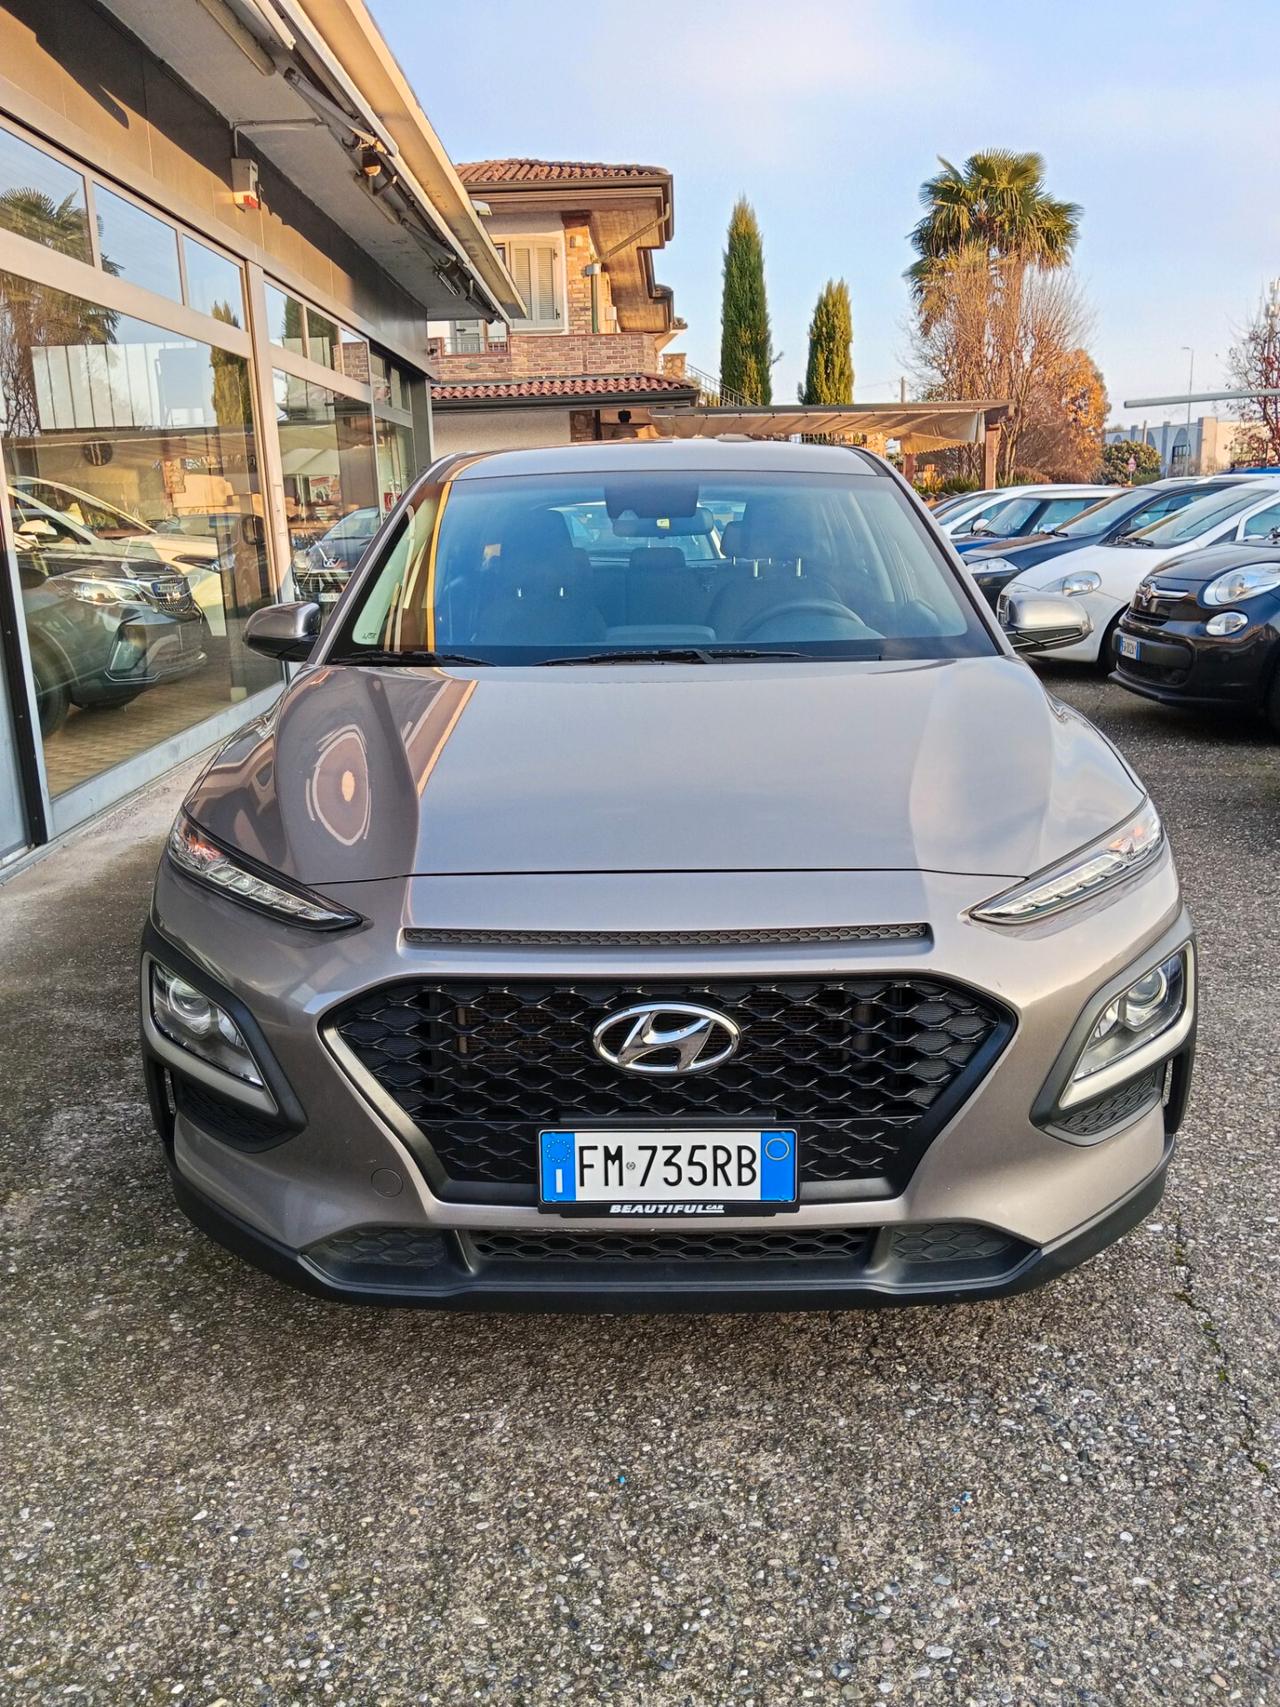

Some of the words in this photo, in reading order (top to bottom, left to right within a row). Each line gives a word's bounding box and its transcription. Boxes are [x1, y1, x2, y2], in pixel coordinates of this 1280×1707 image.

[578, 1145, 624, 1187] FM
[637, 1144, 758, 1187] 735RB
[555, 1168, 563, 1193] I
[609, 1204, 707, 1214] BEAUTIFUL
